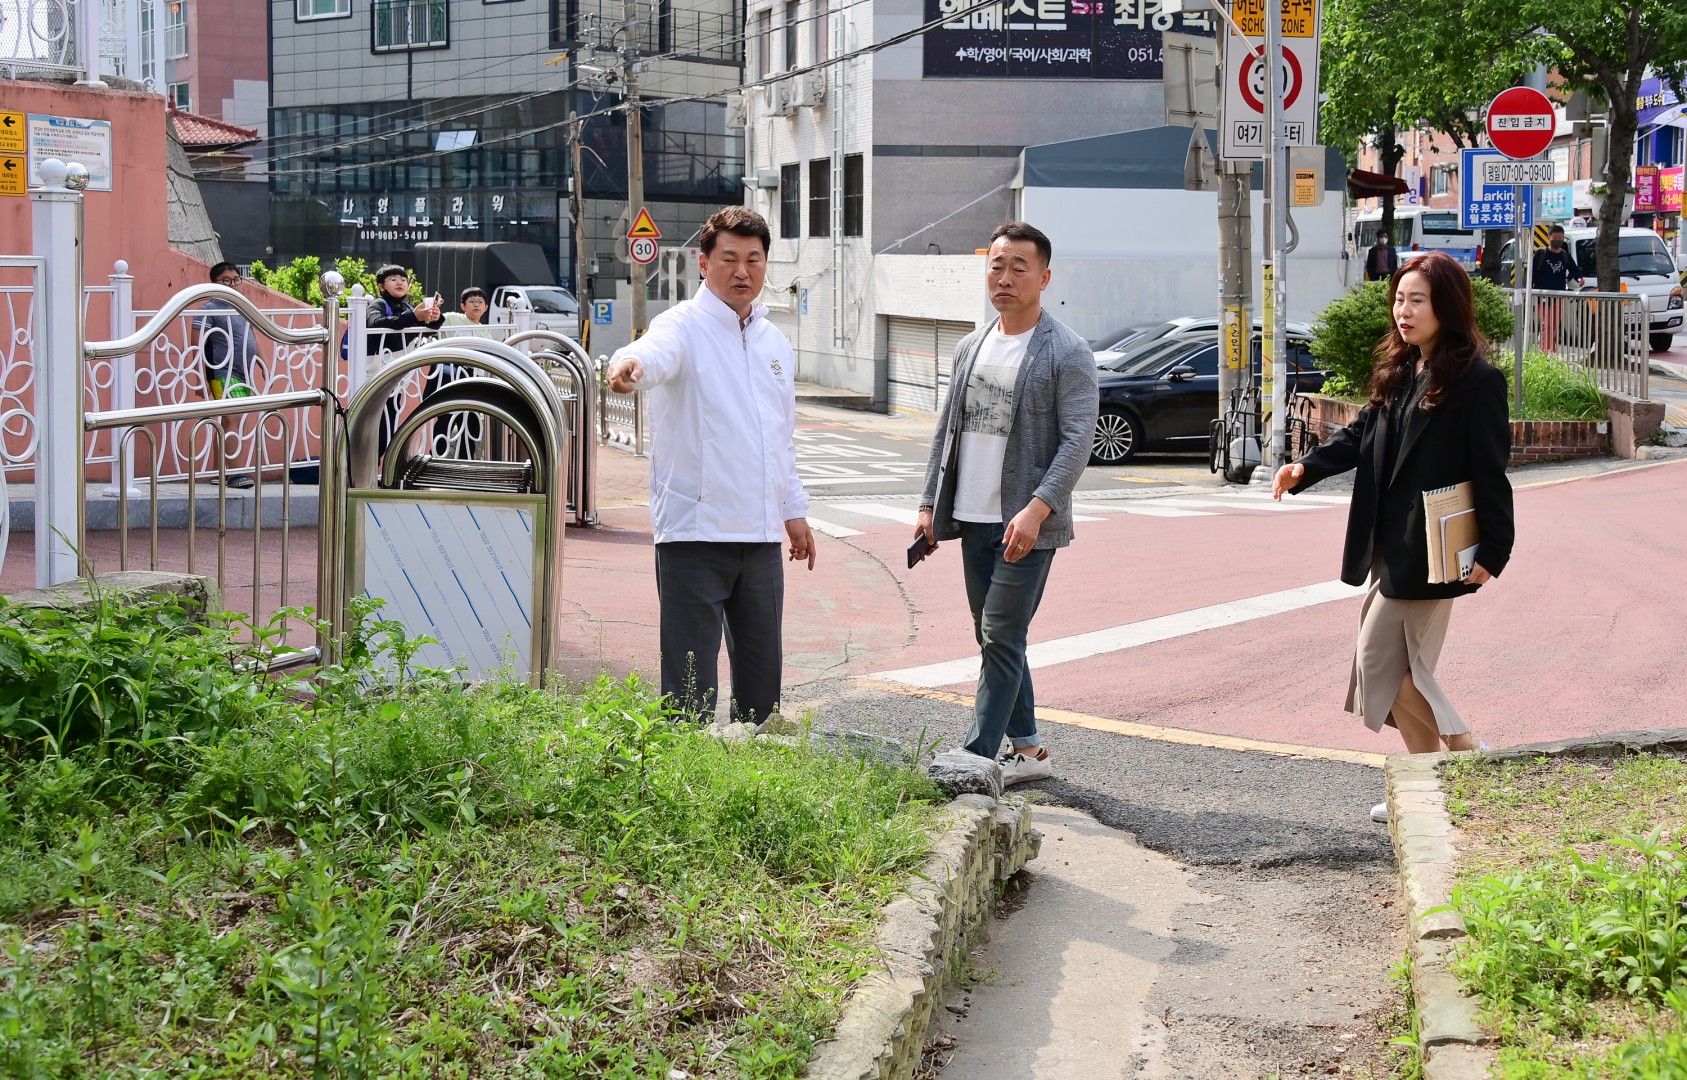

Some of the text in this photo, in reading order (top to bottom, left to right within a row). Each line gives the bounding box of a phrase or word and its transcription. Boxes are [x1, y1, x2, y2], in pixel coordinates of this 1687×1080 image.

[1281, 19, 1305, 34] ZONE
[1498, 117, 1546, 128] 진입금지
[1487, 165, 1500, 181] 평일
[1501, 164, 1551, 181] 07:00~09:00
[635, 243, 652, 255] 30
